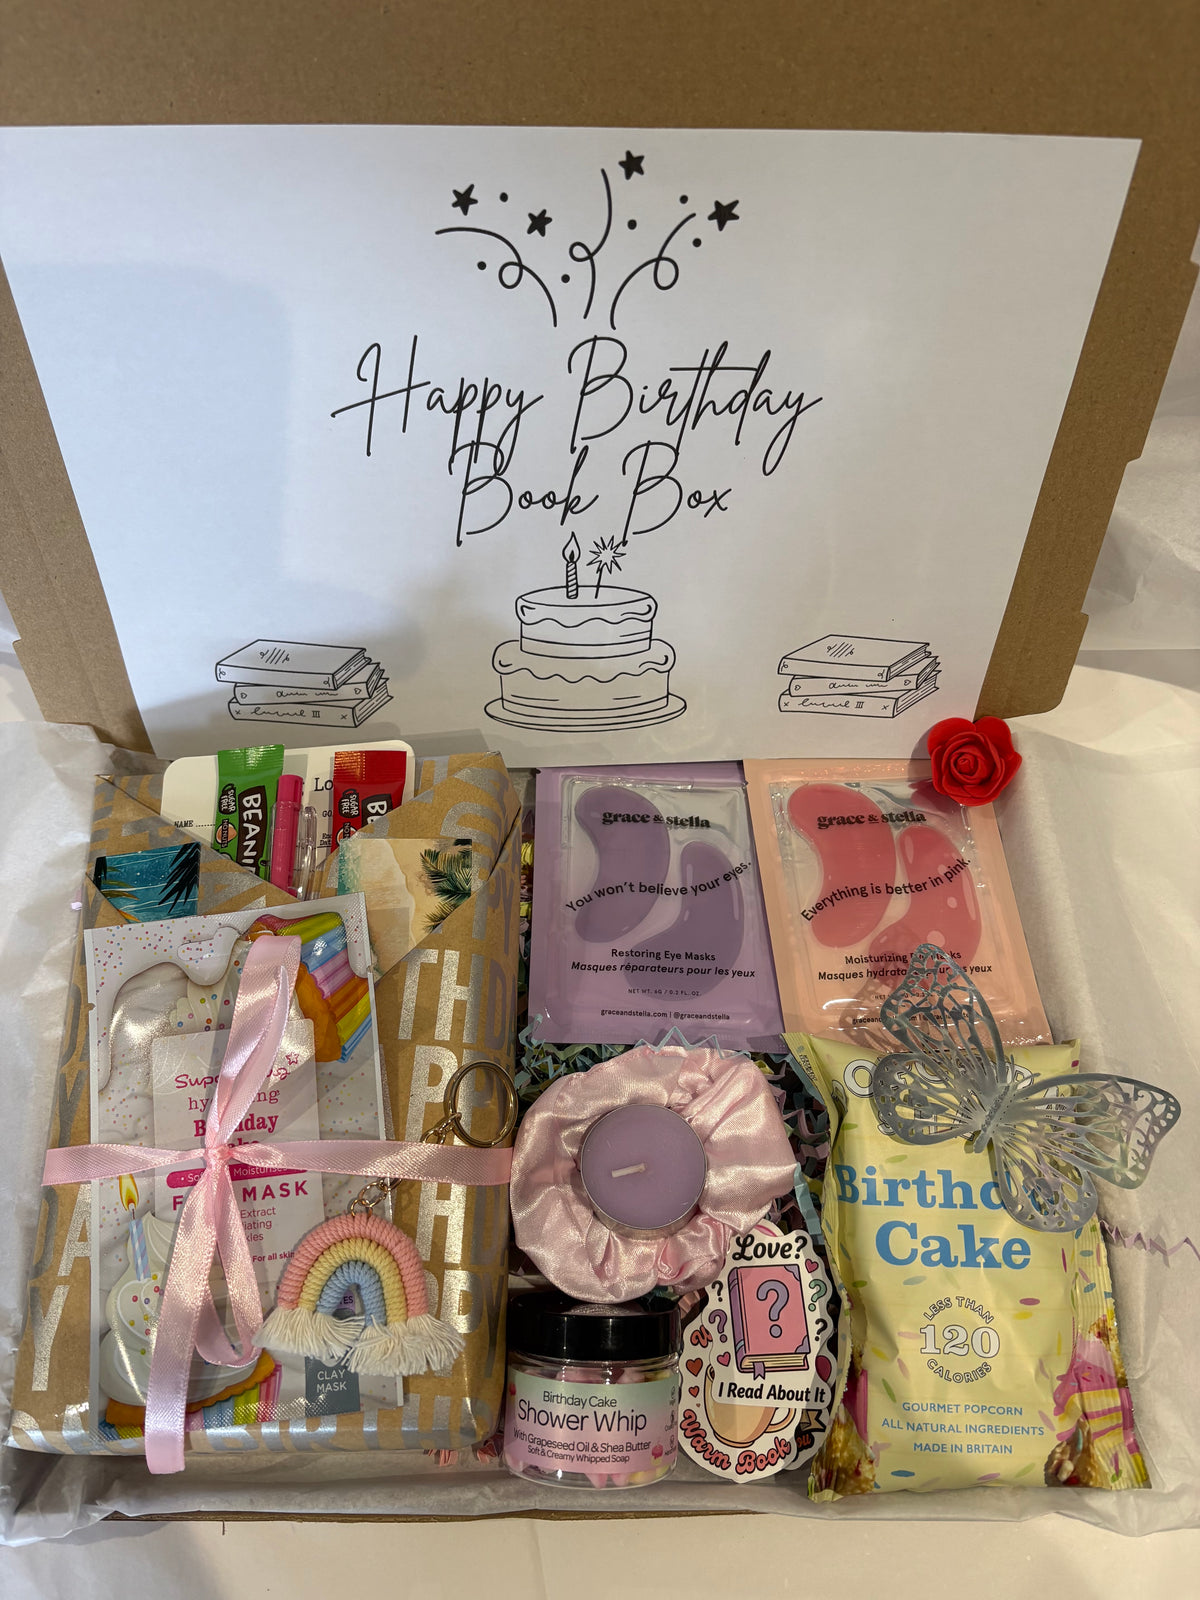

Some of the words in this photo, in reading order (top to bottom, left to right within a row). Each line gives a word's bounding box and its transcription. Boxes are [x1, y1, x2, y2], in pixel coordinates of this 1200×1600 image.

[331, 335, 544, 476] Happy
[568, 335, 823, 476] Birthday
[448, 440, 599, 547] Book
[621, 440, 732, 547] Box
[349, 794, 359, 816] SUGAR
[601, 811, 651, 826] grace
[653, 813, 664, 824] &
[665, 814, 711, 829] stella
[816, 813, 865, 830] grace
[867, 813, 879, 824] &
[880, 810, 927, 824] stella
[565, 893, 593, 913] You
[594, 882, 635, 899] won't
[638, 881, 689, 896] believe
[690, 877, 721, 897] your
[723, 861, 752, 883] eyes.
[800, 882, 869, 922] Everything
[871, 882, 882, 894] is
[885, 880, 928, 895] better
[928, 874, 944, 889] in
[944, 857, 971, 883] pink.
[611, 948, 661, 961] Restoring
[664, 950, 682, 962] Eye
[685, 951, 716, 961] Masks
[845, 952, 909, 965] Moisturizing
[571, 961, 617, 973] Masques
[619, 961, 684, 975] réparateurs
[686, 965, 712, 976] pour
[714, 965, 730, 976] les
[731, 968, 756, 978] yeux
[818, 969, 864, 981] Masques
[866, 967, 907, 979] hydrata
[969, 964, 992, 975] yeux
[600, 1008, 668, 1018] graceandstella.com
[673, 1011, 730, 1020] @graceandstella
[242, 1180, 308, 1202] MASK
[240, 1206, 276, 1219] Extract
[731, 1233, 808, 1261] Love?
[875, 1220, 1032, 1270] Cake
[252, 1255, 265, 1263] For
[267, 1253, 277, 1261] all
[923, 1296, 953, 1321] LESS
[956, 1295, 994, 1325] THAN
[919, 1323, 1001, 1359] 120
[317, 1368, 346, 1380] CLAY
[926, 1358, 993, 1384] CALORIES
[316, 1381, 348, 1393] MASK
[718, 1381, 724, 1397] I
[727, 1381, 764, 1400] Read
[766, 1384, 811, 1402] About
[814, 1386, 826, 1403] It
[543, 1390, 587, 1409] Birthday
[588, 1396, 617, 1408] Cake
[902, 1401, 961, 1414] GOURMET
[963, 1404, 1023, 1416] POPCORN
[517, 1398, 589, 1431] Shower
[594, 1409, 647, 1436] Whip
[881, 1417, 904, 1431] ALL
[906, 1420, 962, 1434] NATURAL
[964, 1424, 1045, 1437] INGREDIENTS
[513, 1427, 527, 1442] With
[528, 1433, 575, 1451] Grapeseed
[576, 1441, 590, 1452] Oil
[590, 1442, 599, 1452] &
[600, 1441, 624, 1453] Shea
[625, 1440, 651, 1452] Butter
[680, 1409, 732, 1470] Warm
[735, 1436, 792, 1475] Book
[913, 1441, 948, 1453] MADE
[949, 1443, 963, 1454] IN
[966, 1443, 1013, 1455] BRITAIN
[528, 1445, 541, 1456] Soft
[546, 1450, 575, 1463] Creamy
[576, 1453, 611, 1464] Whipped
[611, 1454, 630, 1464] Soap
